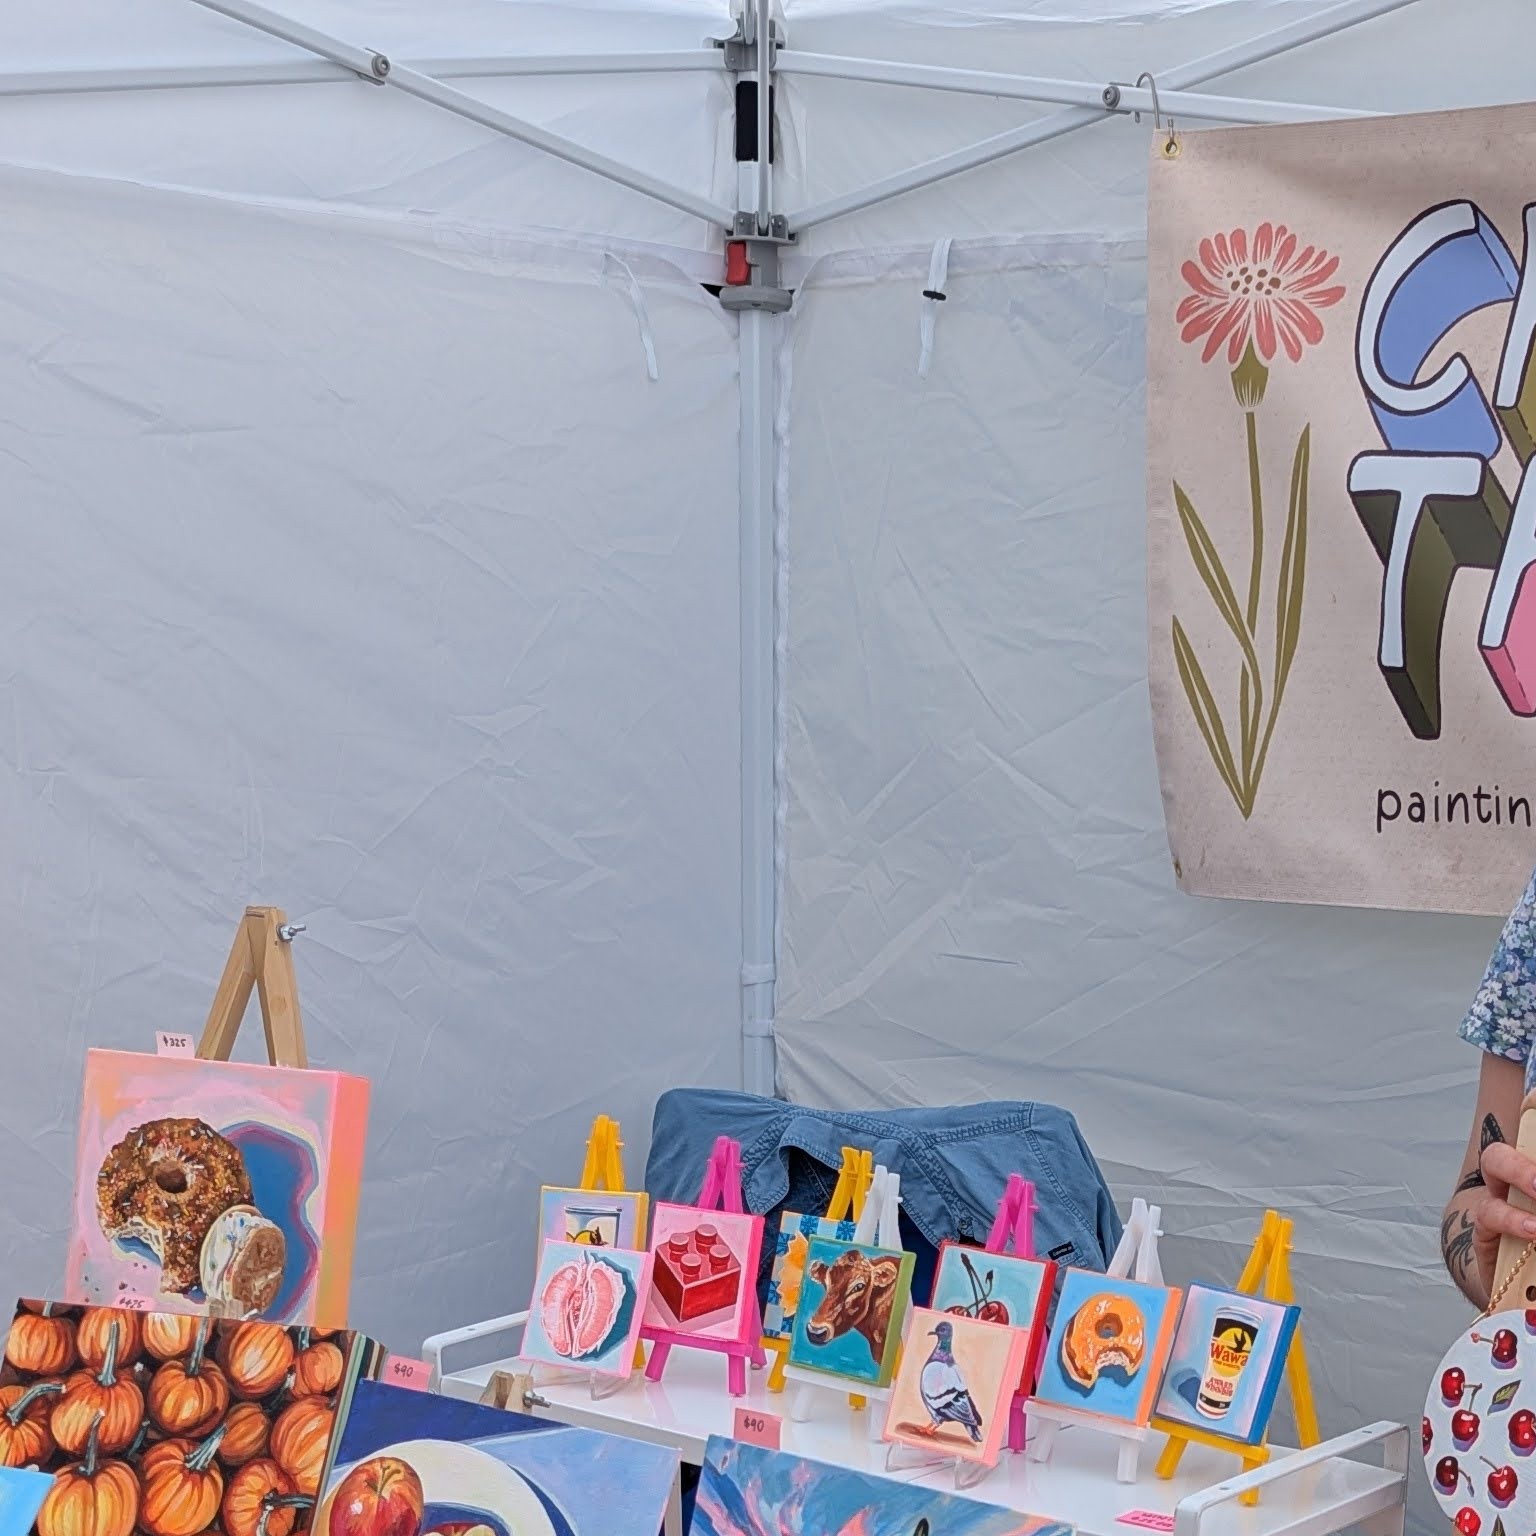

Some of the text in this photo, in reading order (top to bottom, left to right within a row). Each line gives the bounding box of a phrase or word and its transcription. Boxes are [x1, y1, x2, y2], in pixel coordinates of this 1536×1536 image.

[1210, 1342, 1249, 1367] Wawa
[394, 1362, 414, 1378] $90
[744, 1415, 765, 1433] $90
